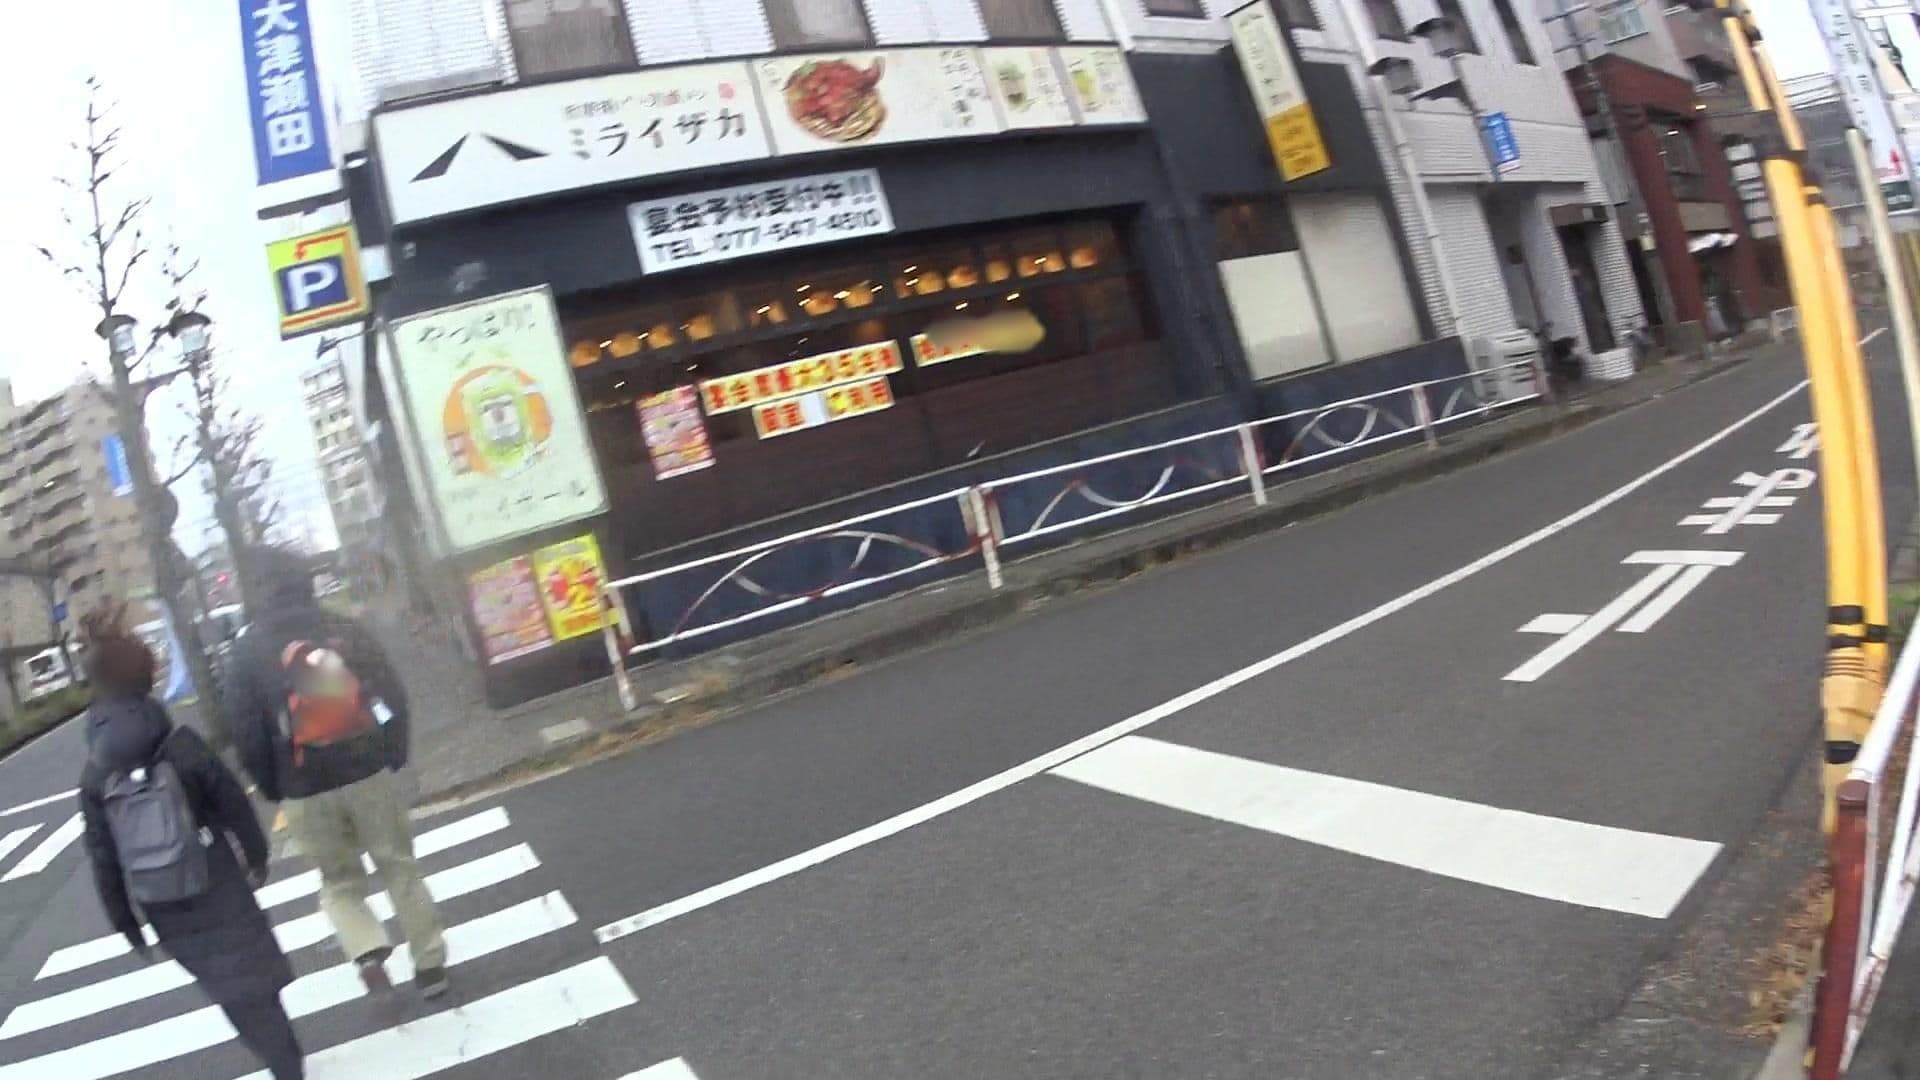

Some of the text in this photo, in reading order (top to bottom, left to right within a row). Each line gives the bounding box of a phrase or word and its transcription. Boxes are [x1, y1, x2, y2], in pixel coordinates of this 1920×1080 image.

[569, 107, 746, 160] ミライザカ
[286, 262, 340, 312] P
